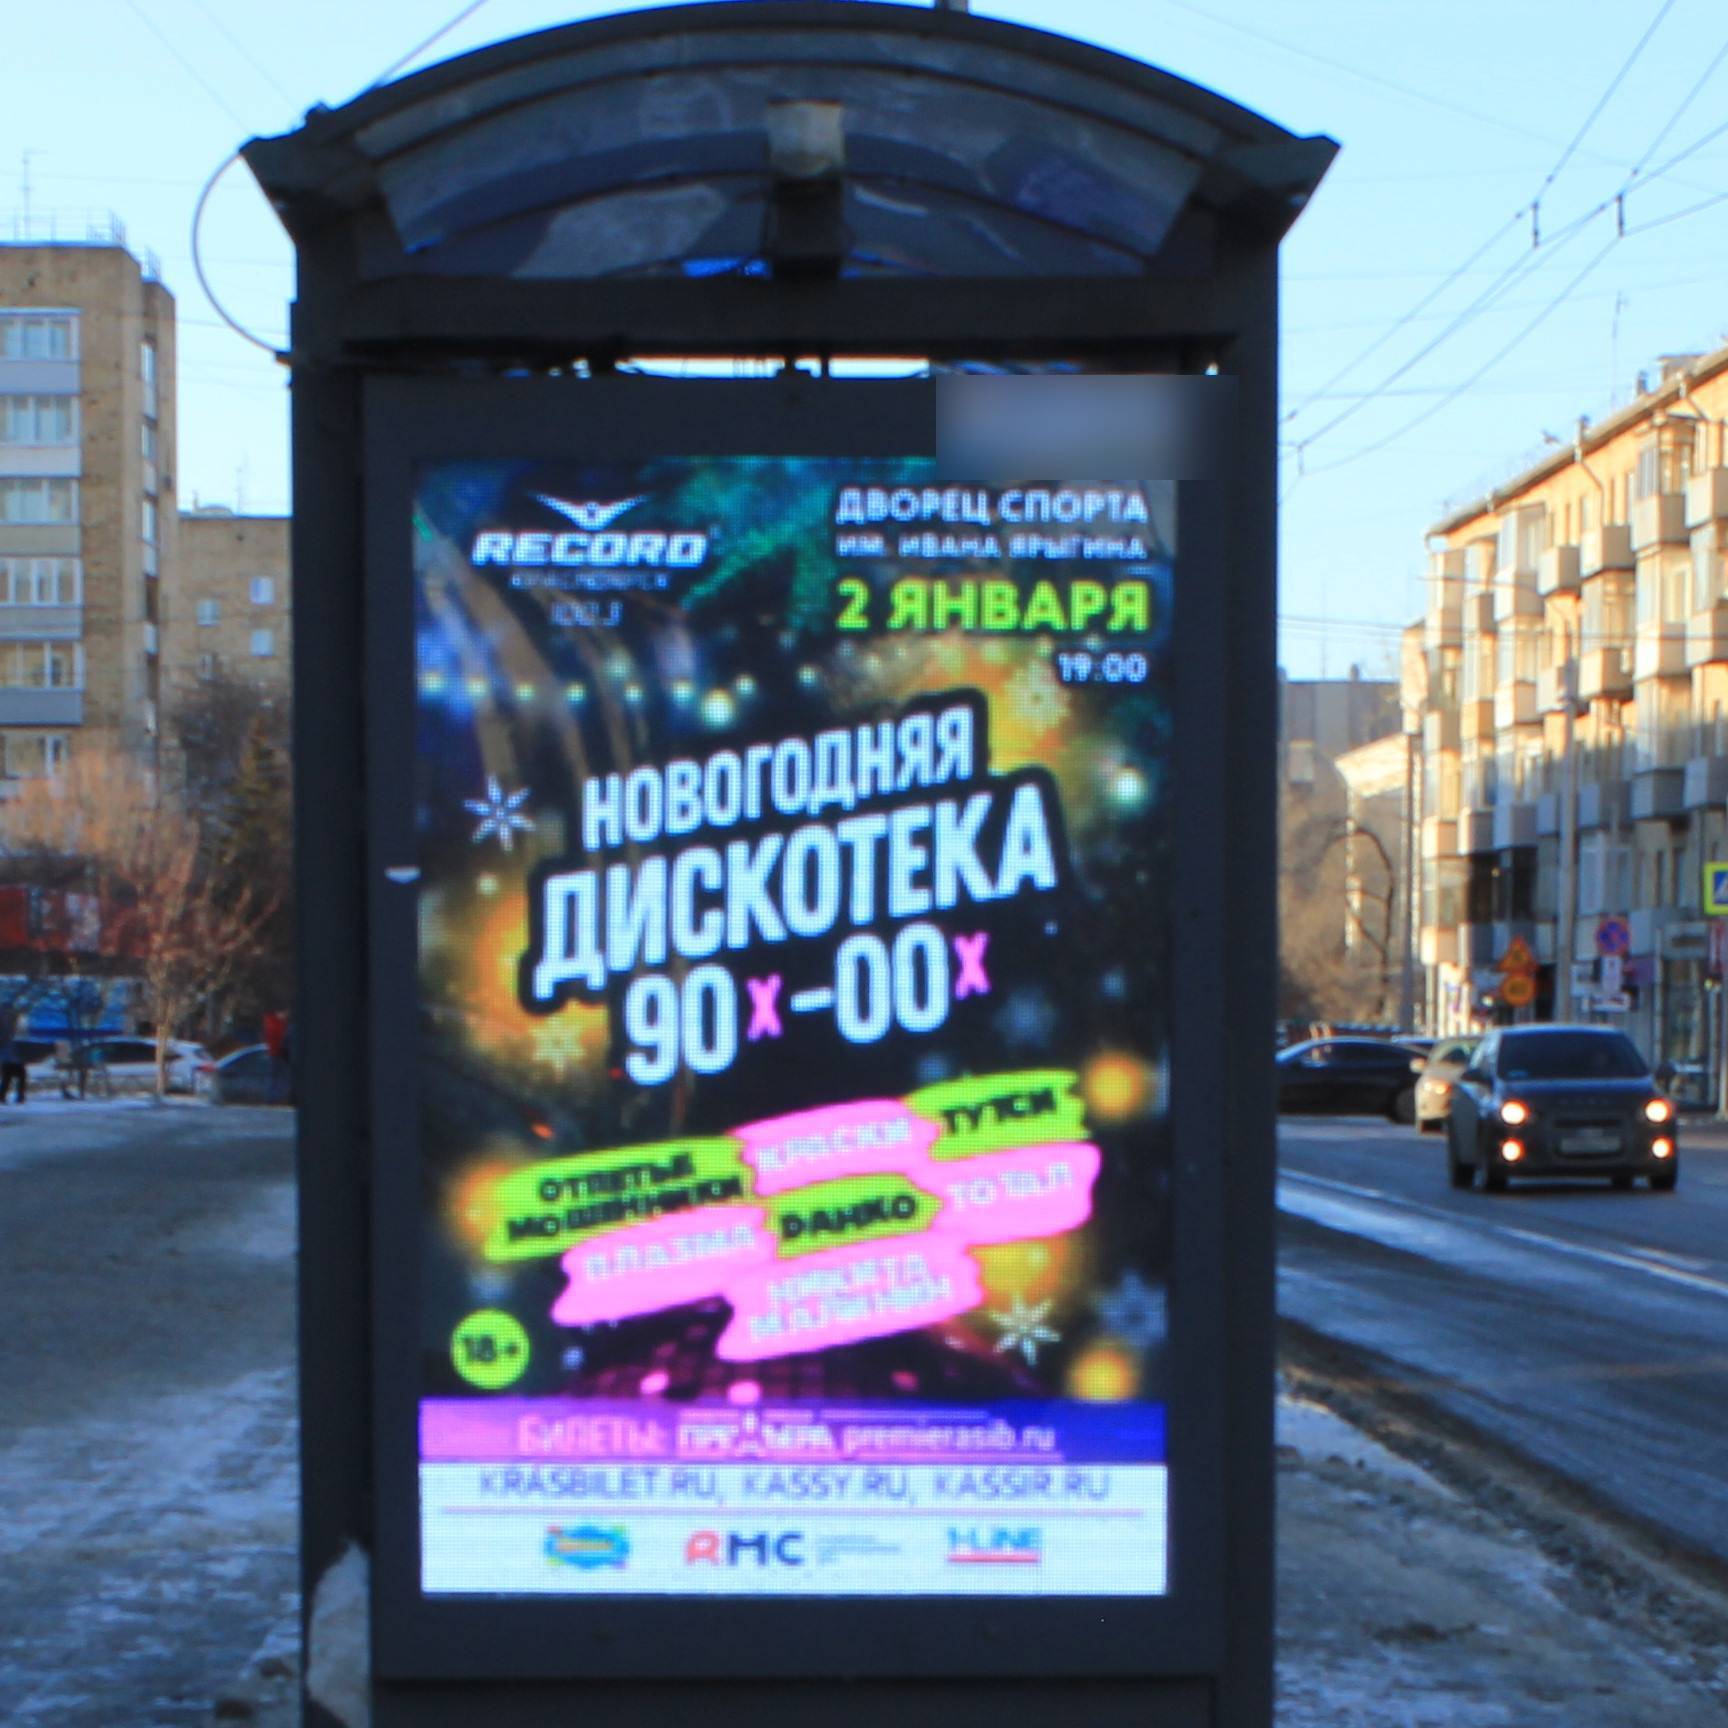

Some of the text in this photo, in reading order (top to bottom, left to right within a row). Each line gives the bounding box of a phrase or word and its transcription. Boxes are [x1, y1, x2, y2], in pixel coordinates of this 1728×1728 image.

[835, 487, 1148, 526] ДВОРЕЦ СПОРТА
[473, 531, 708, 568] RECORD
[835, 577, 1149, 633] 2 ЯНВАРЯ
[1058, 652, 1148, 683] 19:00
[582, 706, 974, 852] НОВОГОДНЯЯ
[534, 783, 1056, 1002] ДИСКОТЕКА
[460, 1333, 519, 1364] 18+
